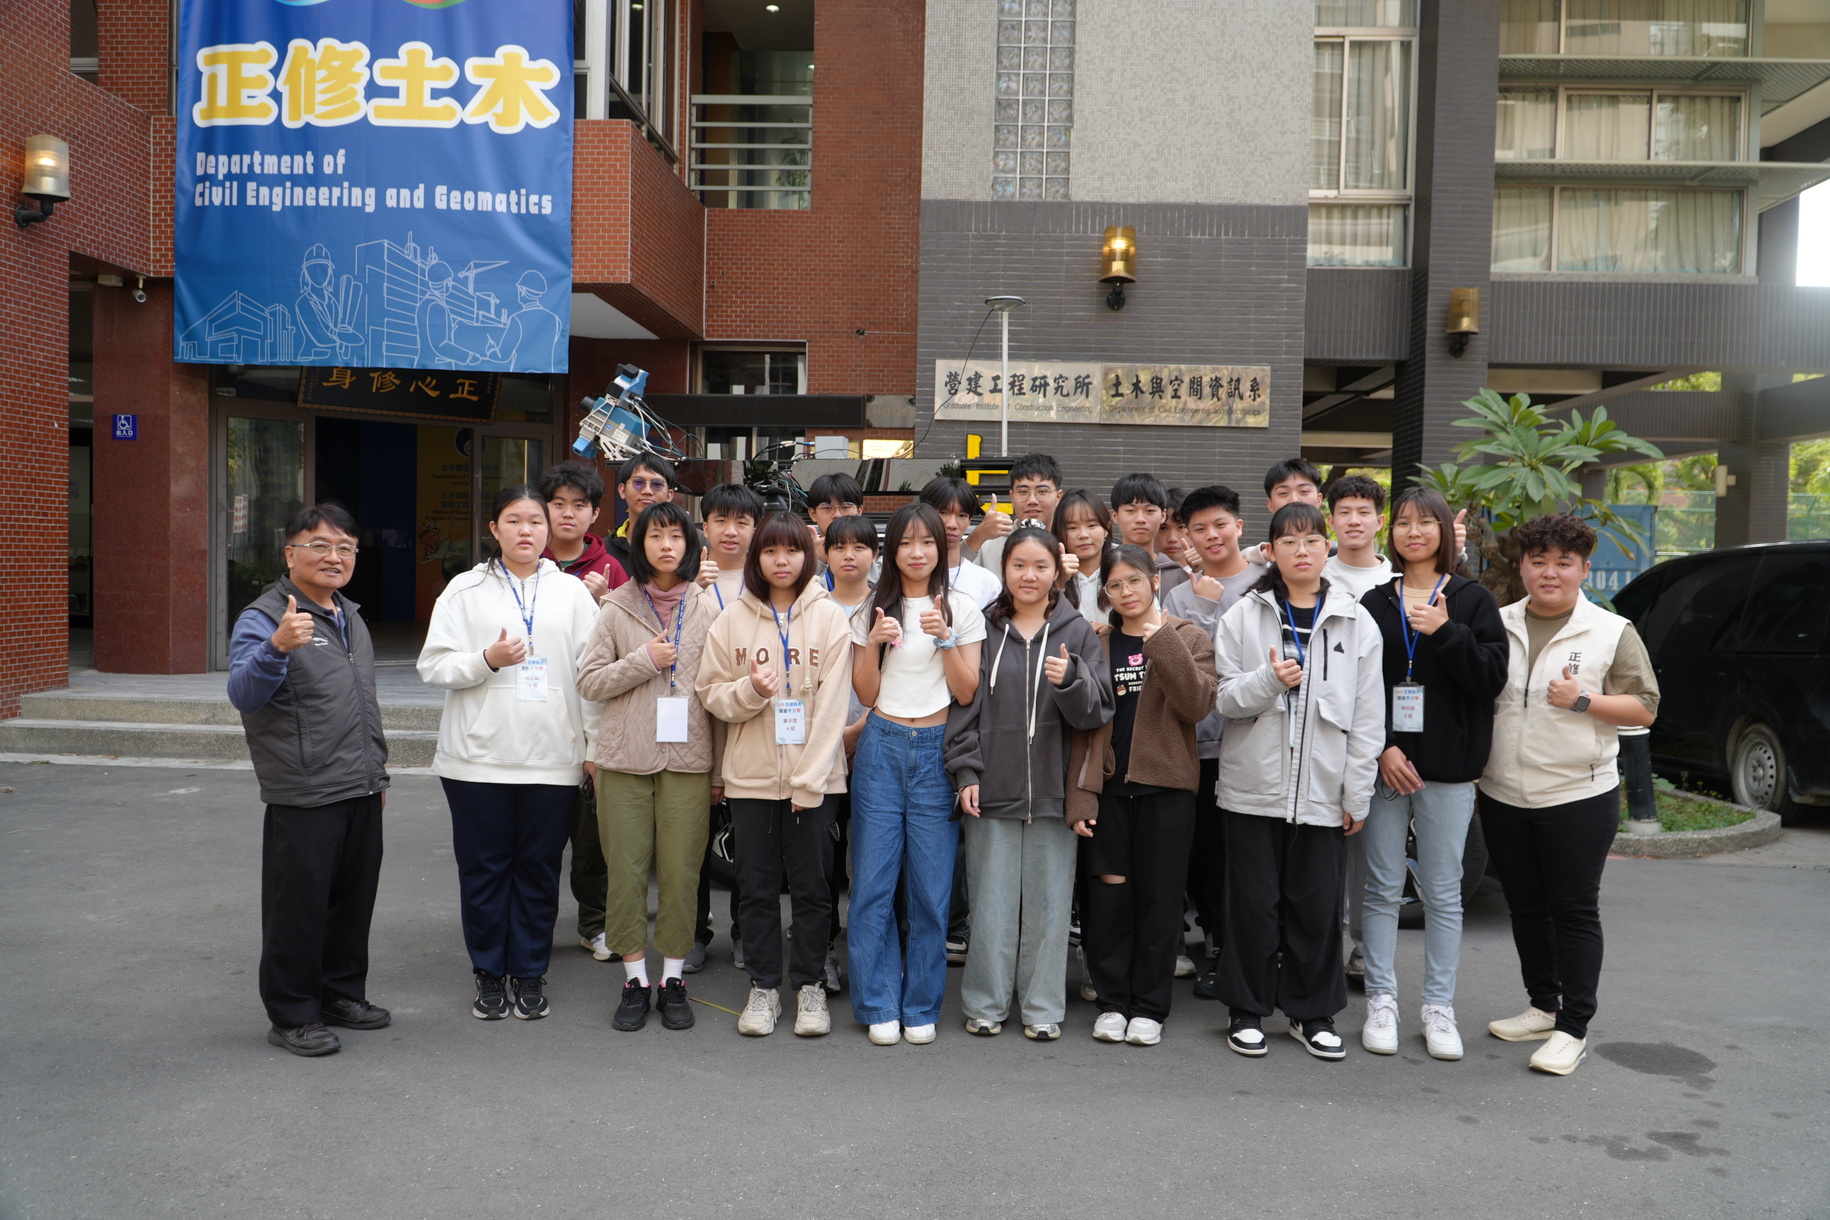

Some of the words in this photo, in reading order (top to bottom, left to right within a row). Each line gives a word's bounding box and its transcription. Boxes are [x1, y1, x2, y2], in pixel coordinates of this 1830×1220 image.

[193, 38, 561, 134] 正修土木
[196, 150, 314, 181] Department
[322, 148, 346, 175] of
[194, 180, 238, 207] Civil
[246, 181, 376, 212] Engineering
[385, 183, 425, 208] and
[434, 185, 553, 215] Geomatics
[944, 370, 1093, 399] 營建工程研究所
[1110, 374, 1261, 402] 土木與空間資訊系
[943, 403, 972, 411] Graduate
[975, 403, 1000, 411] Institute
[1014, 403, 1053, 412] Construction
[1057, 404, 1093, 414] Engineering
[1109, 404, 1146, 415] Department
[735, 647, 819, 667] MORE
[1568, 652, 1582, 675] 正修
[1114, 672, 1137, 682] TSUM
